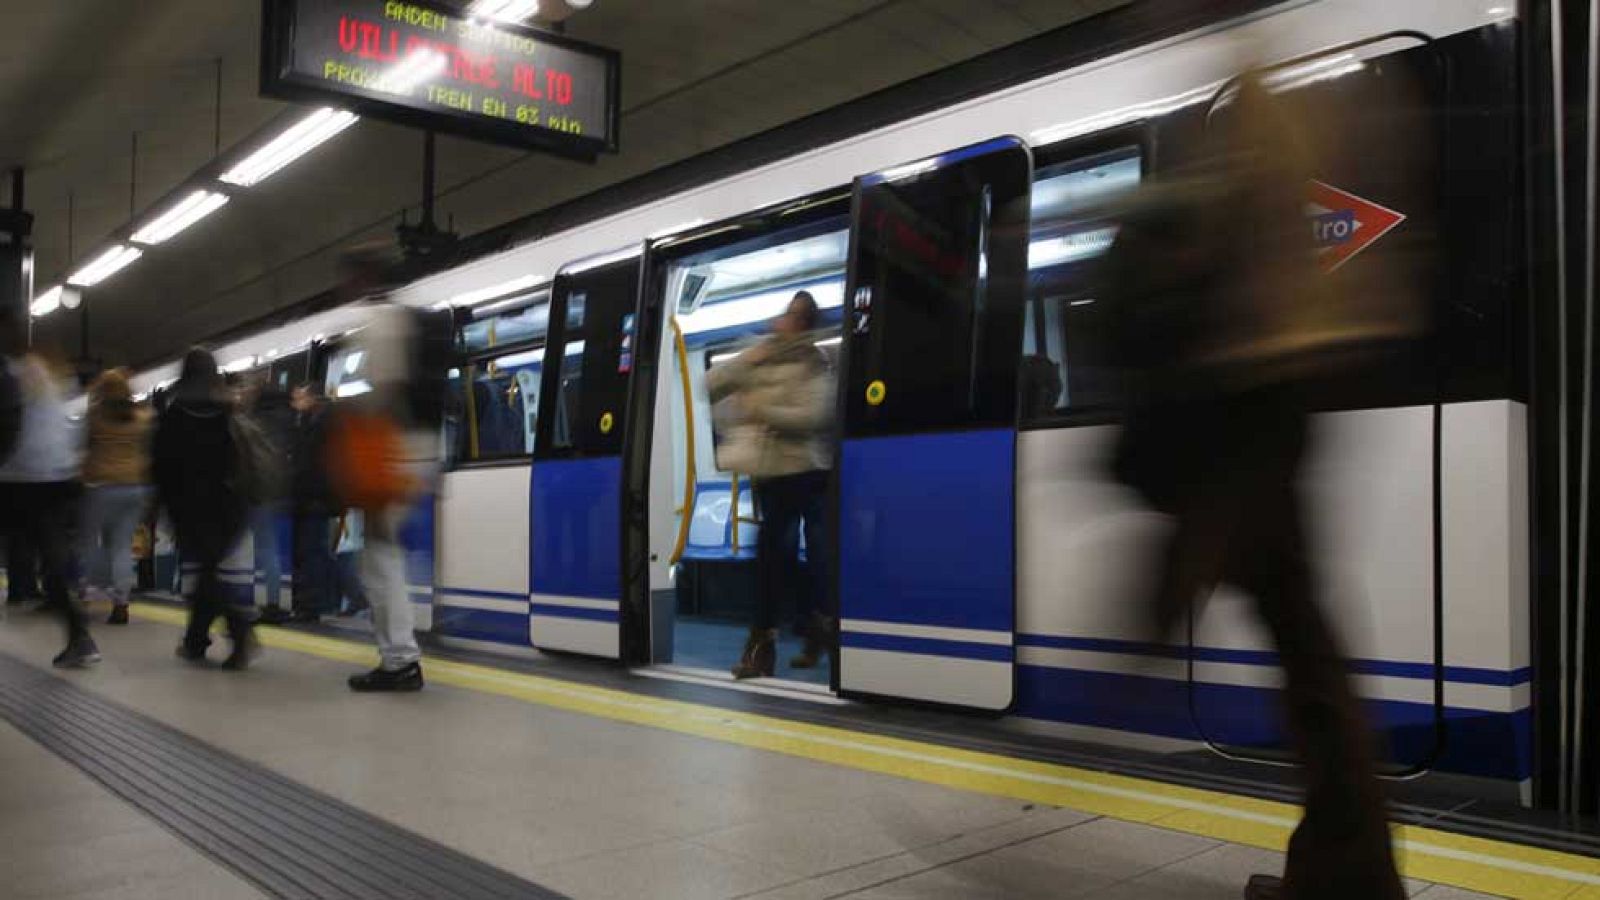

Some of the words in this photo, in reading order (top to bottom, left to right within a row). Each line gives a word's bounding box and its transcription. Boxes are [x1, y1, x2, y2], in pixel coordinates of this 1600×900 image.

[384, 1, 446, 31] ANDEN
[338, 15, 499, 89] VILLRDE
[512, 63, 573, 106] ALTO
[426, 84, 472, 112] TREN
[482, 97, 506, 119] EN
[515, 104, 539, 125] 03
[1312, 218, 1348, 241] tro
